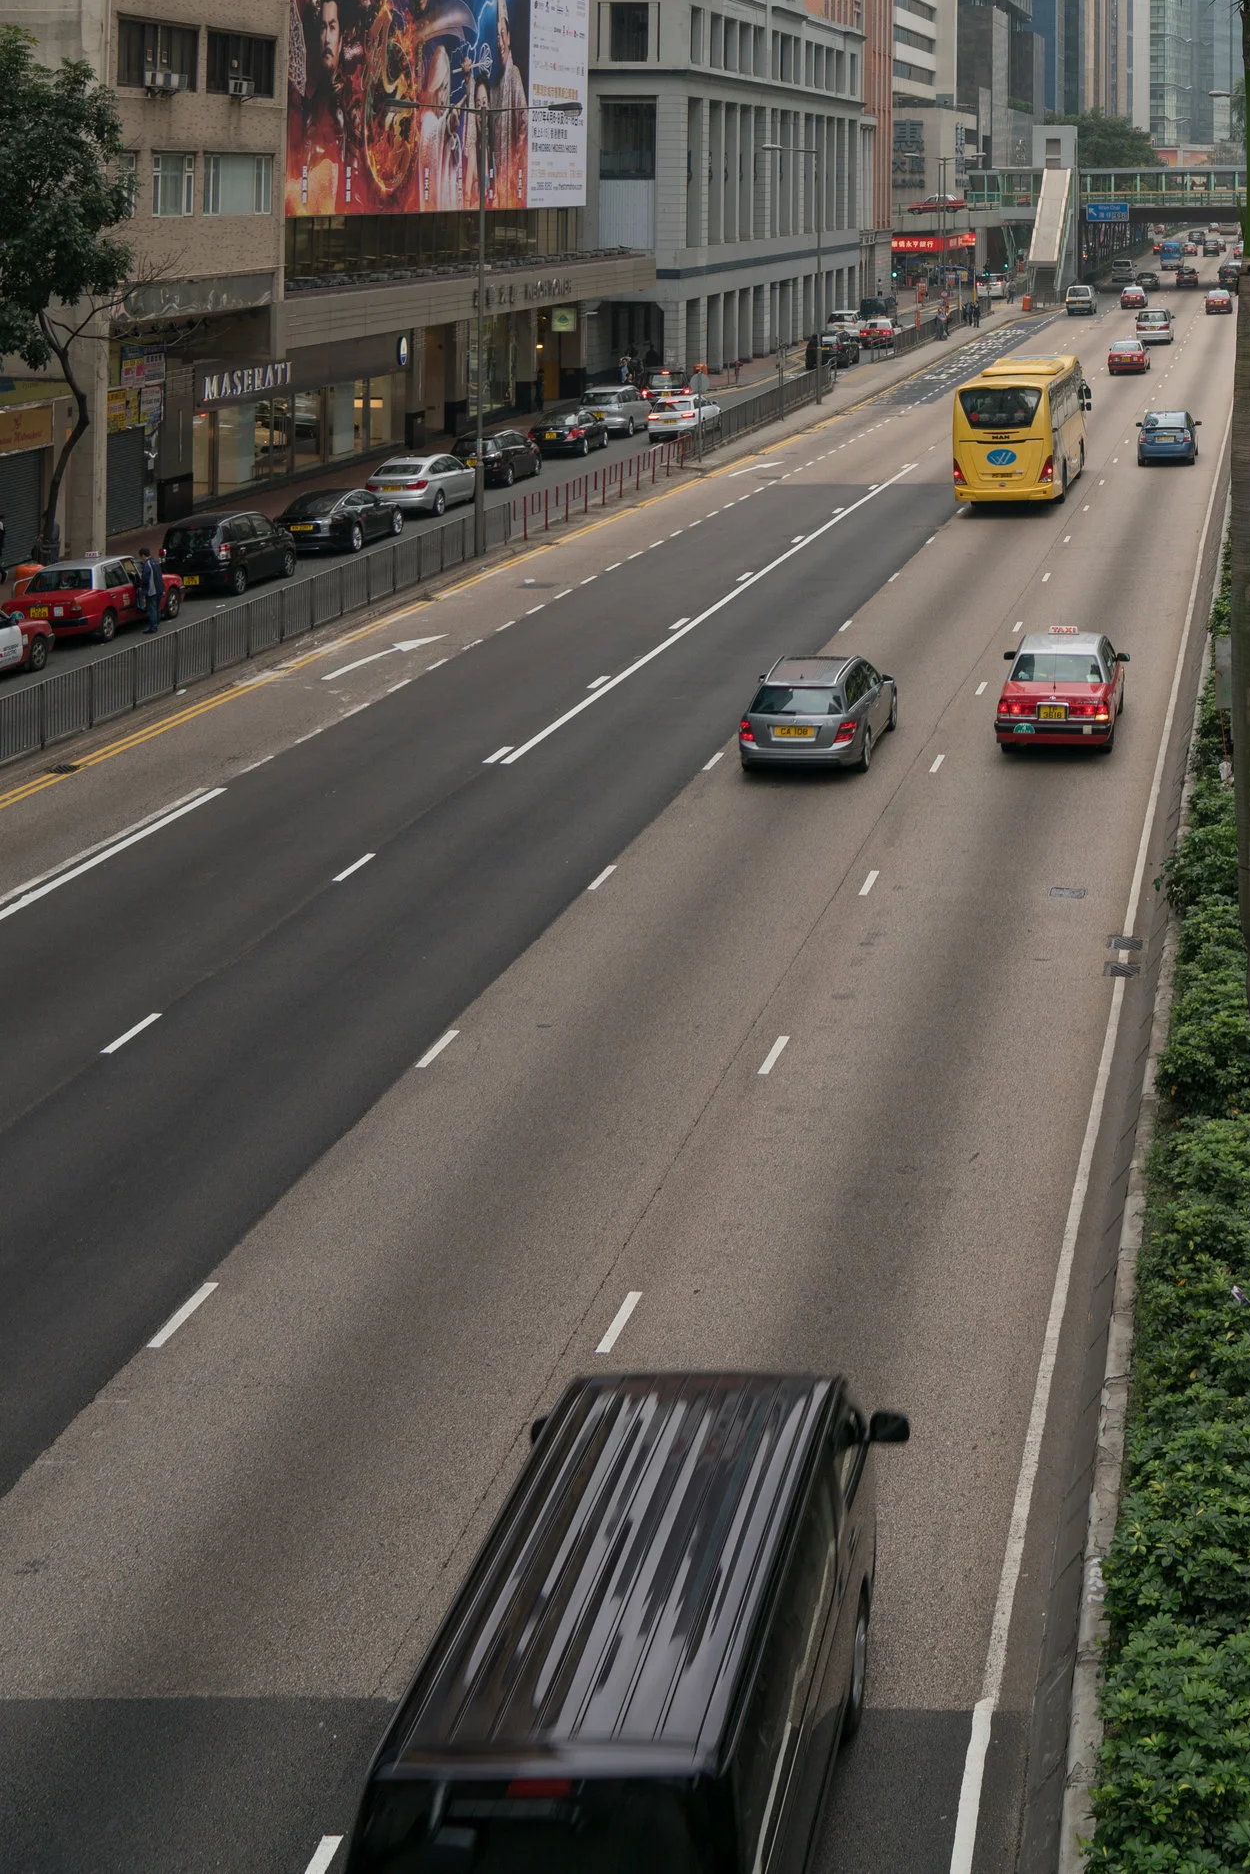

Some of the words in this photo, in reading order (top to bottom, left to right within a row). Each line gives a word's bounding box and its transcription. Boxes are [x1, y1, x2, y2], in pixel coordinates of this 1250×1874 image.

[203, 362, 293, 401] MASERATI
[780, 727, 791, 736] CA
[794, 727, 809, 736] 108
